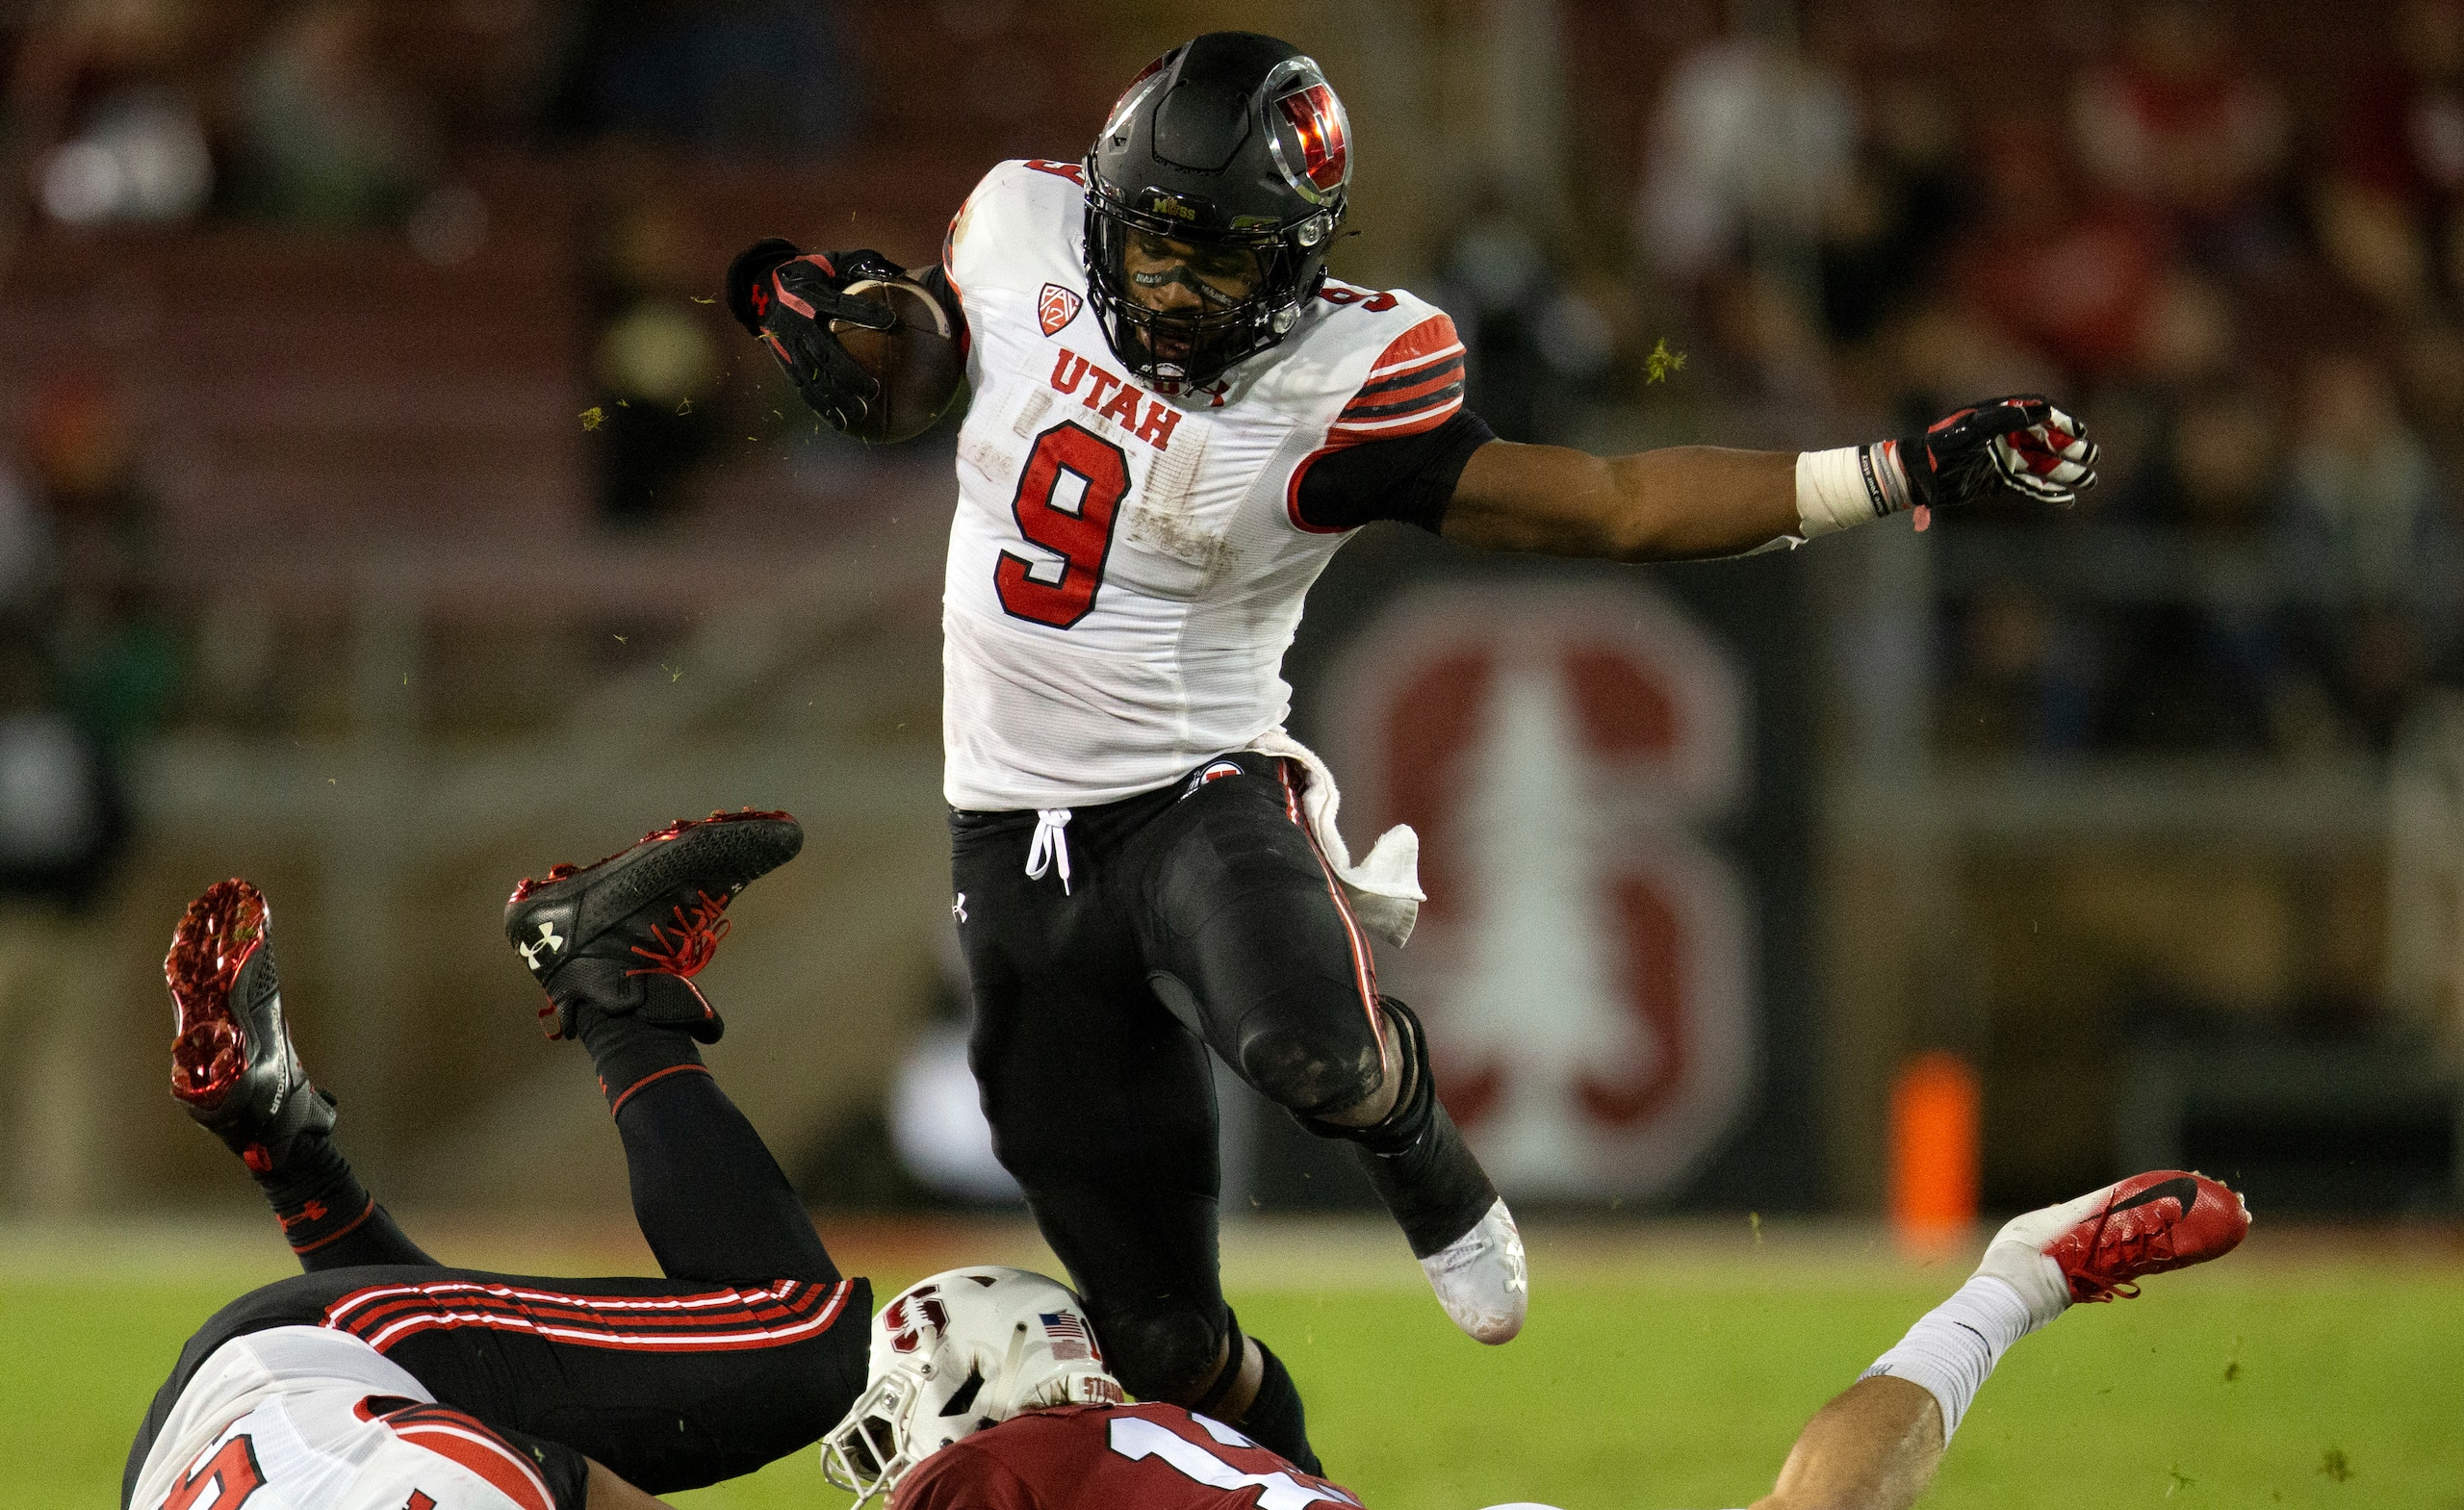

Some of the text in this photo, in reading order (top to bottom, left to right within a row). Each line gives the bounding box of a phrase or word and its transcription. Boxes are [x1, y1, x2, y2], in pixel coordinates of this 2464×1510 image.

[1040, 286, 1081, 322] PAC
[1042, 306, 1065, 327] 12
[1050, 347, 1183, 452] UTAH
[993, 419, 1132, 630] 9
[1084, 1376, 1125, 1404] STAN
